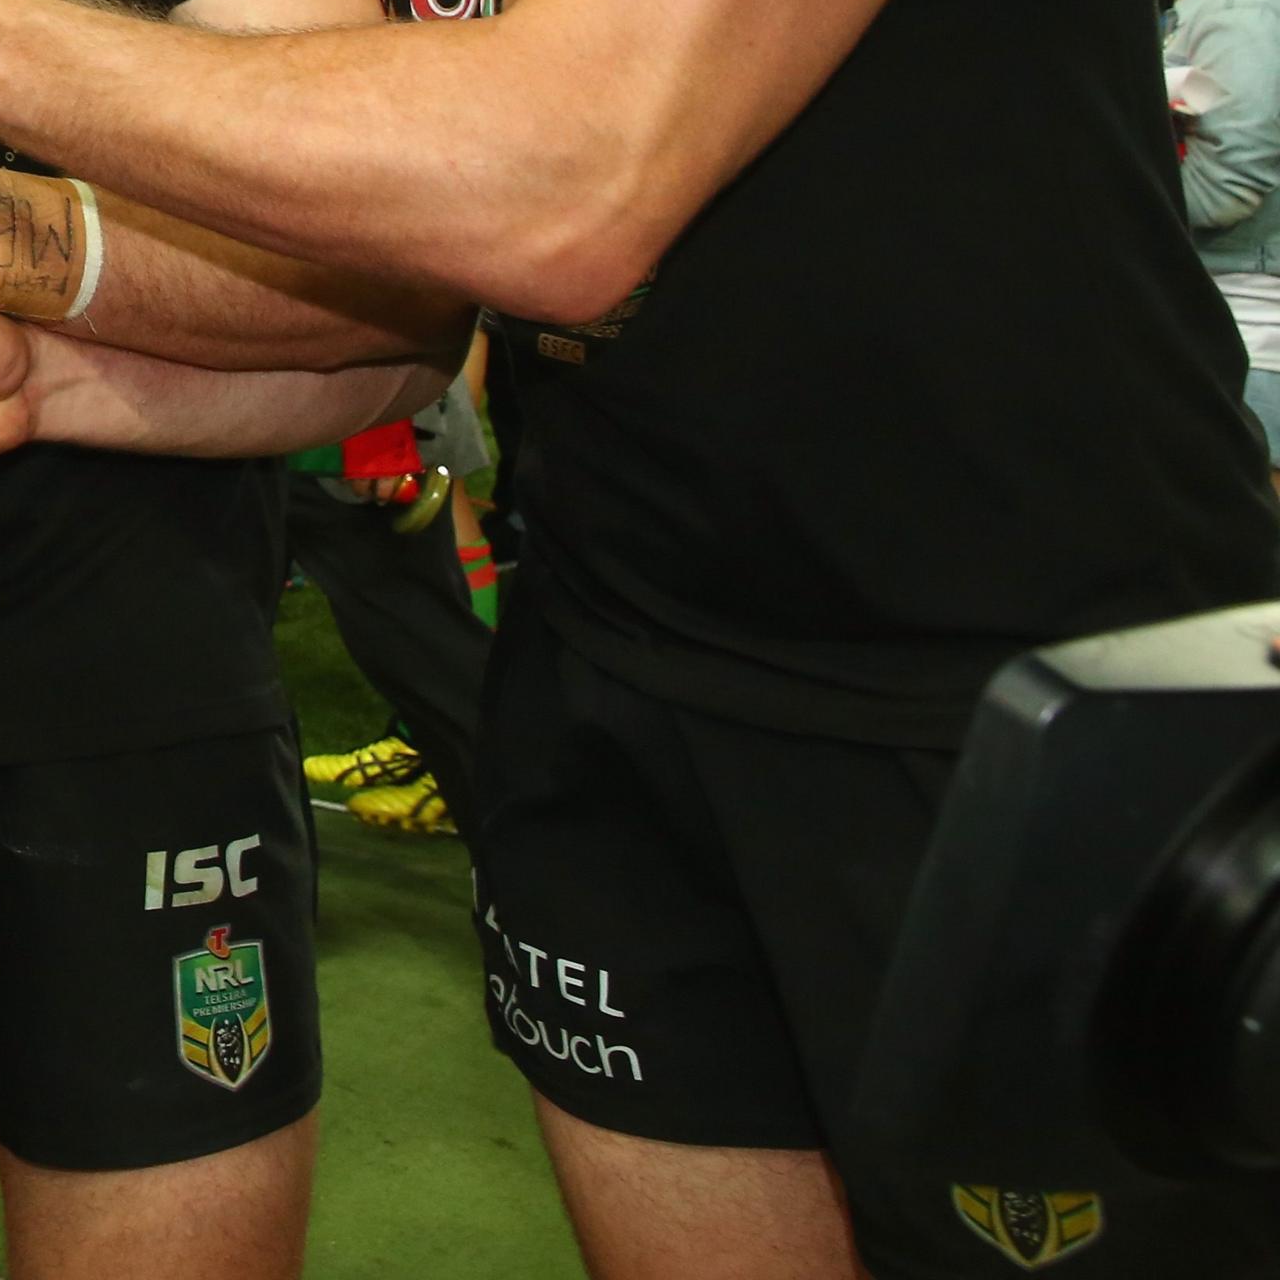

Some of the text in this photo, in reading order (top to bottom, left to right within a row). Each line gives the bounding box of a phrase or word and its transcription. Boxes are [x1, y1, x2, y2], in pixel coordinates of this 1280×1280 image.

[144, 834, 260, 910] ISC
[194, 960, 256, 994] NRL
[193, 998, 258, 1017] PREMIERSHIP
[203, 989, 248, 1006] TELSTRA
